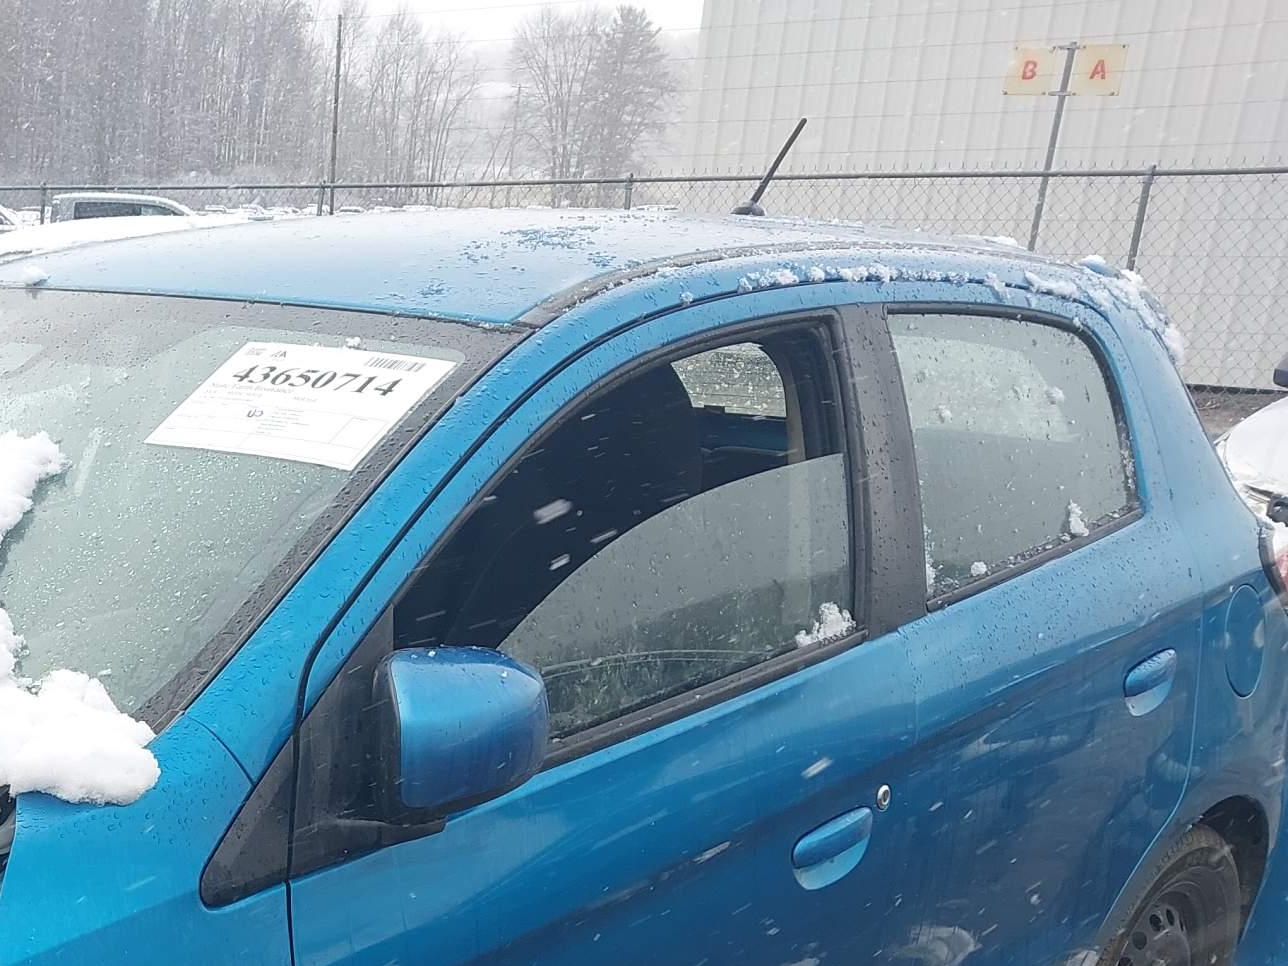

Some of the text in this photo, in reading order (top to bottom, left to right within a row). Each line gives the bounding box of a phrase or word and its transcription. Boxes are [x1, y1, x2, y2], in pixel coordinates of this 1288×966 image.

[1021, 60, 1038, 80] B
[1089, 59, 1106, 80] A
[232, 364, 404, 397] 43650714
